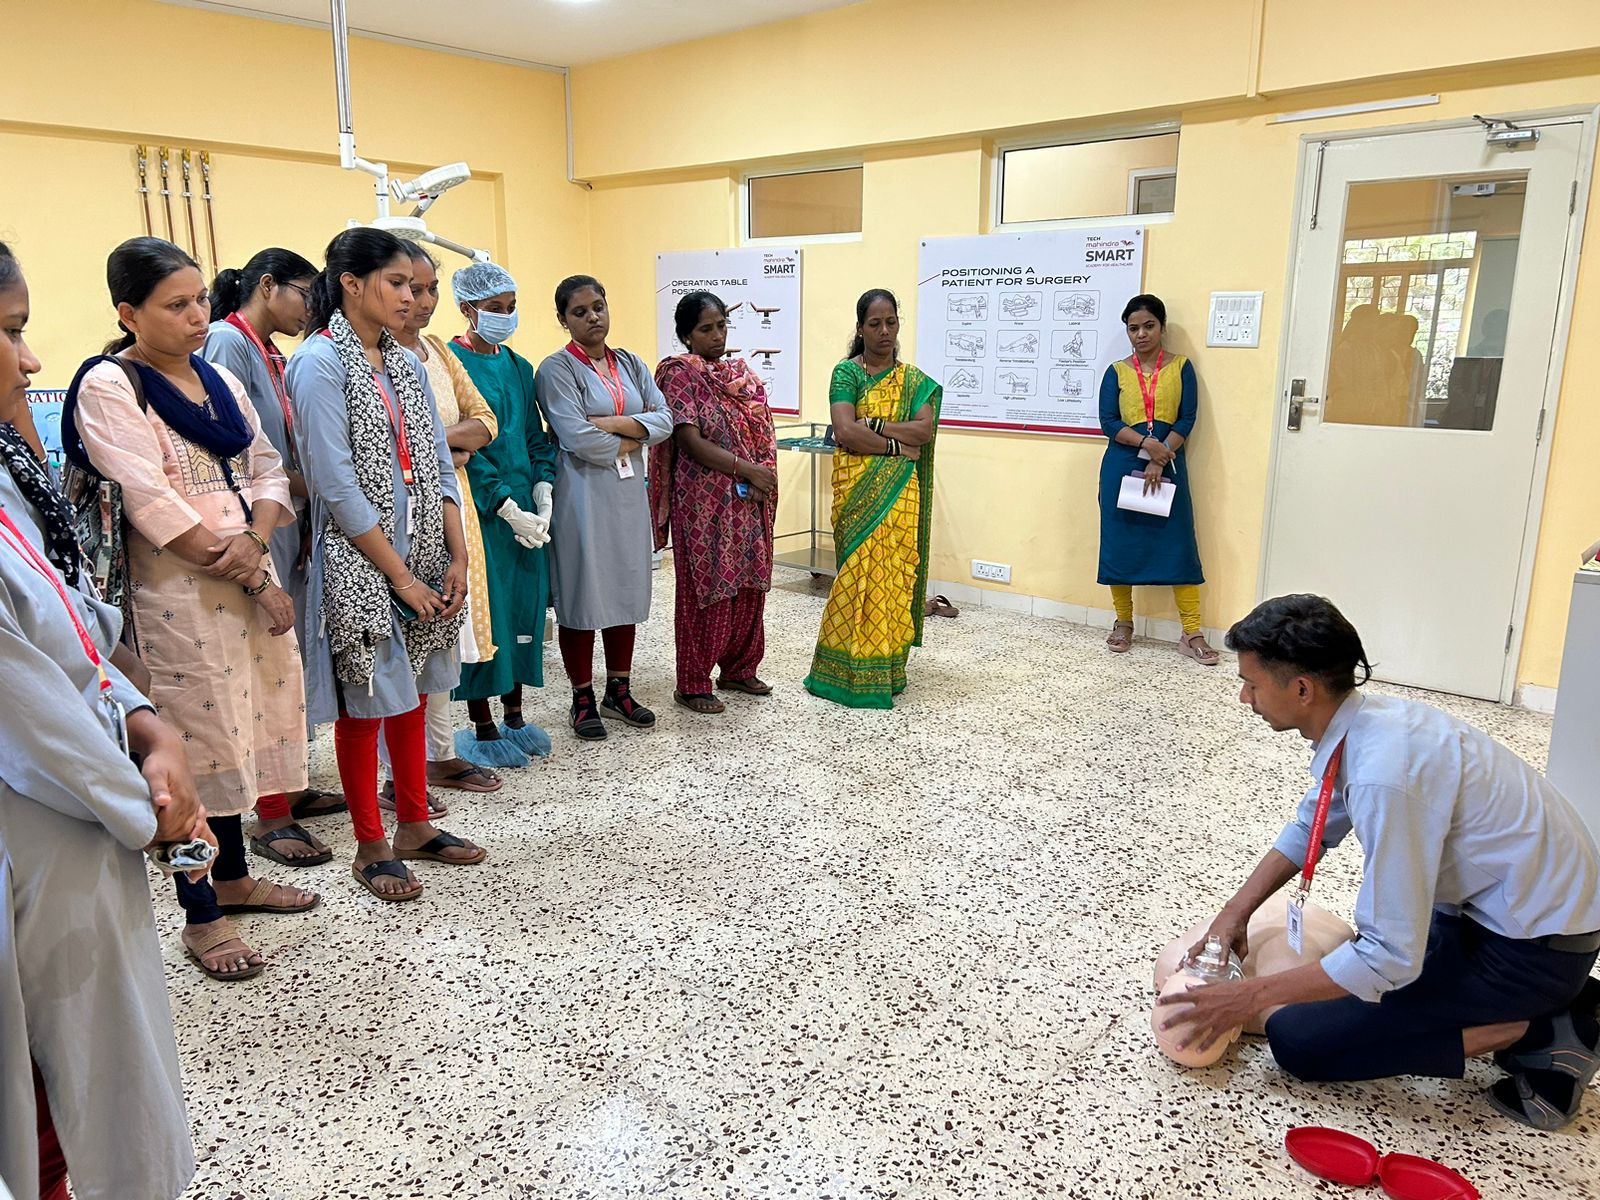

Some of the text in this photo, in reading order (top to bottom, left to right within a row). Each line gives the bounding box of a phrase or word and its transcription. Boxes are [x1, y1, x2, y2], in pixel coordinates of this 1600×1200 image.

[1085, 248, 1135, 262] SMART
[763, 264, 795, 274] SMART
[941, 266, 1035, 277] POSITIONING A
[671, 278, 748, 287] OPERATING TABLE
[941, 275, 1092, 287] PATIENT FOR SURGERY
